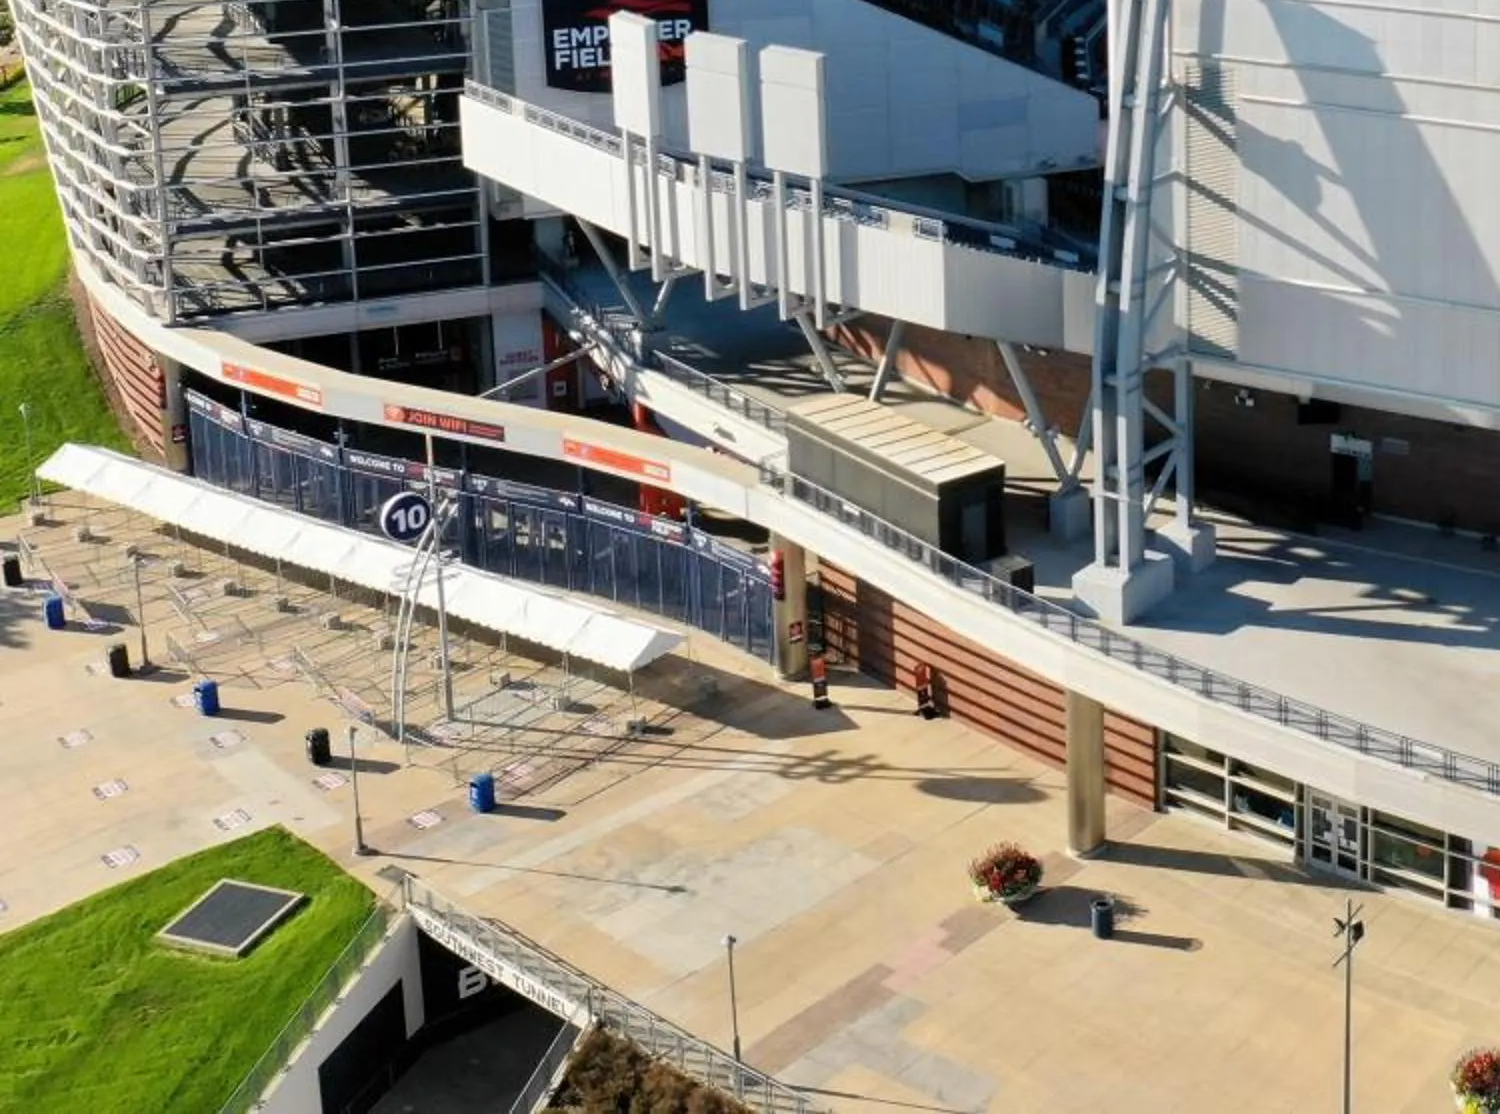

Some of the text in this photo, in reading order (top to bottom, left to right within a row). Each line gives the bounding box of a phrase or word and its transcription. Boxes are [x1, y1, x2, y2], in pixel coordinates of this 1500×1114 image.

[553, 19, 691, 49] EMPER
[555, 48, 612, 71] FIEL
[408, 410, 438, 427] JOIN
[349, 455, 405, 473] WELCOME TO
[391, 505, 427, 533] 10
[424, 919, 505, 978] SOUTHWEST
[511, 973, 571, 1018] TUNNEL
